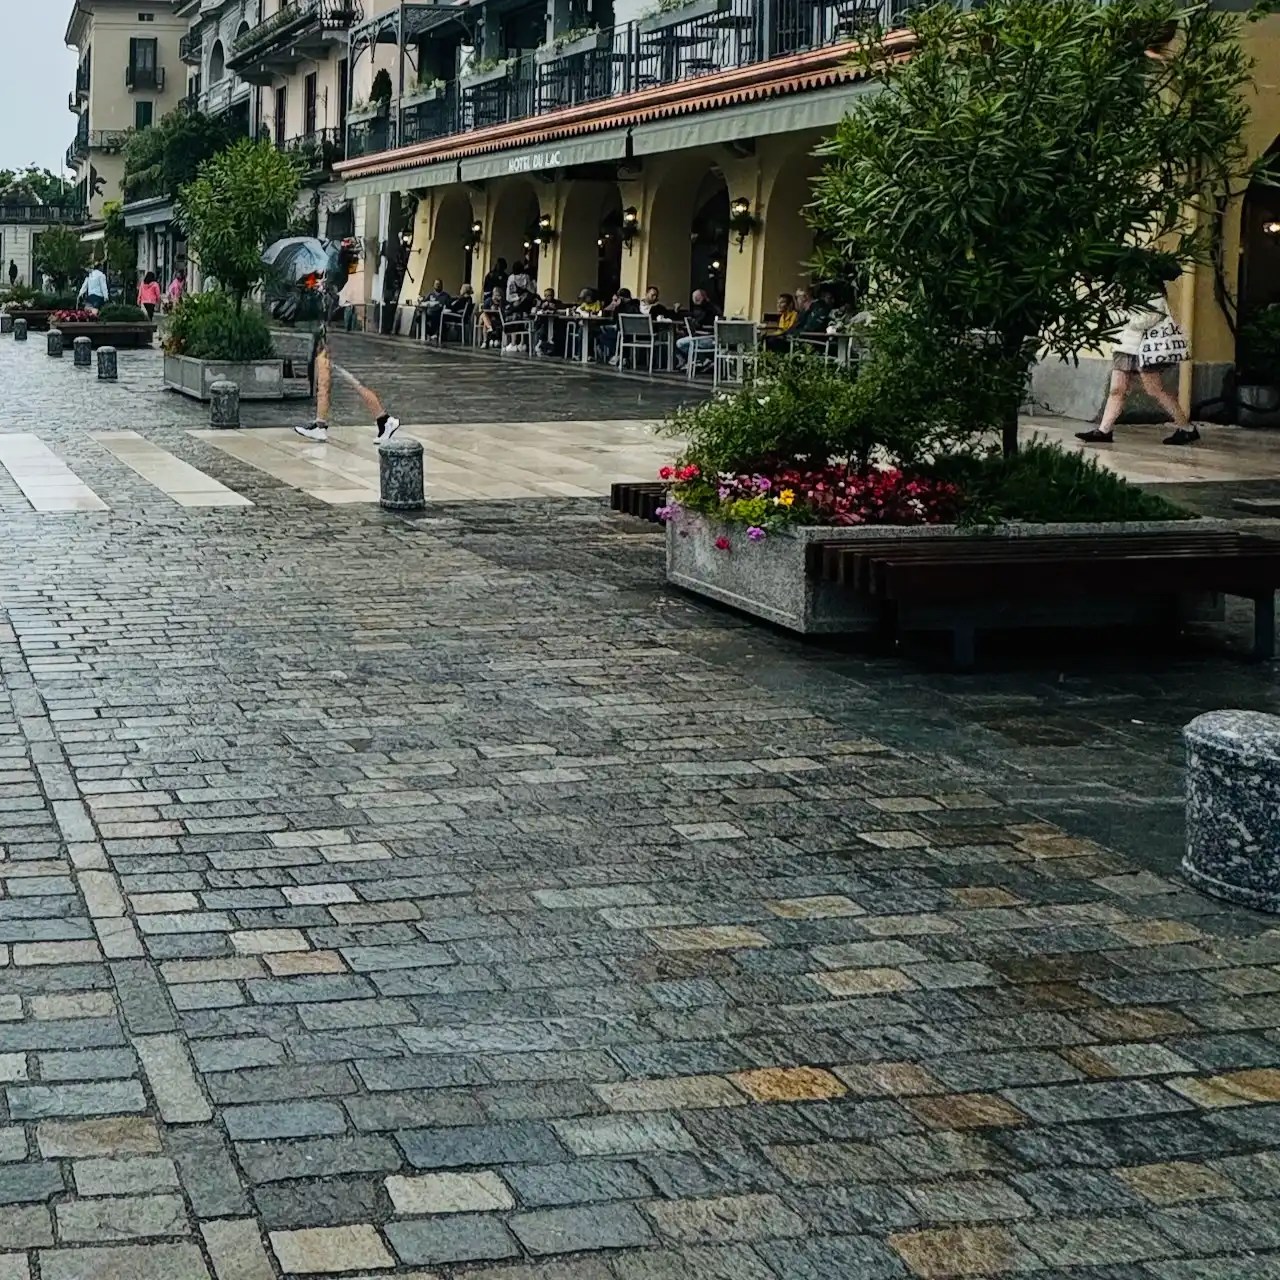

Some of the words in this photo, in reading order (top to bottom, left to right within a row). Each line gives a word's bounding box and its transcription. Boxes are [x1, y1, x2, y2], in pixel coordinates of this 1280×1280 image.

[508, 156, 531, 172] HOTEL
[532, 154, 544, 167] DU
[545, 150, 561, 166] LAC
